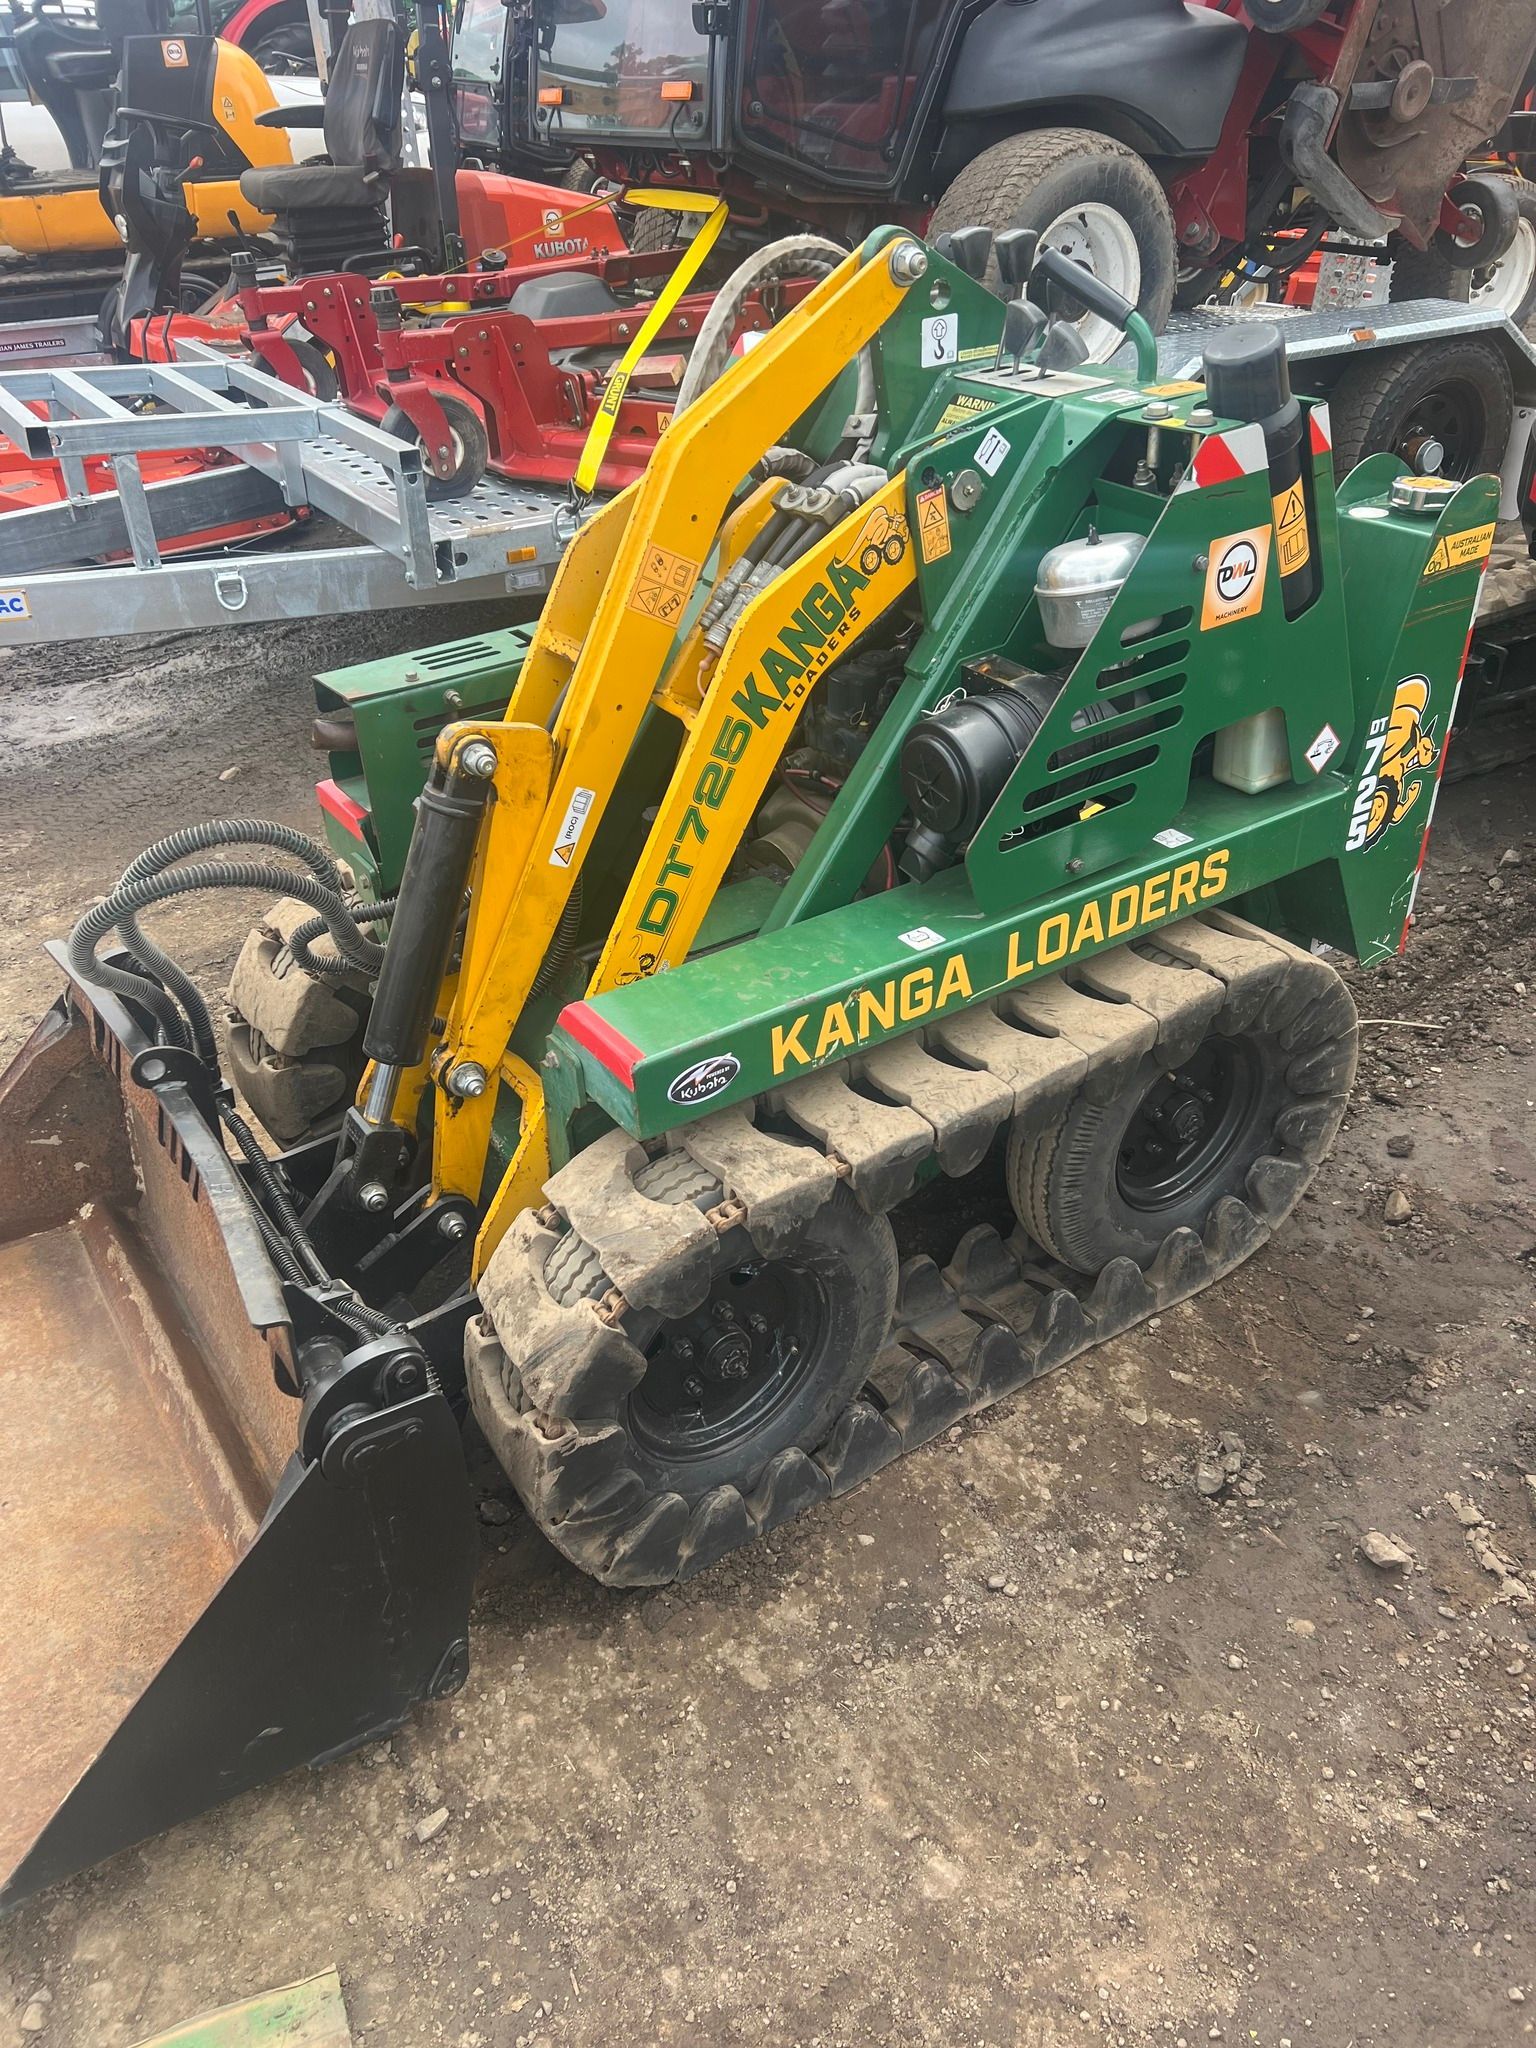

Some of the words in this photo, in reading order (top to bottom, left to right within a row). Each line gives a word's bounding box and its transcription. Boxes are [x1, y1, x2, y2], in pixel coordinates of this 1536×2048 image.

[533, 237, 589, 259] KUBOTA
[14, 342, 34, 351] JAMES
[34, 339, 65, 348] TRAILERS
[604, 375, 626, 412] GRUNT
[956, 395, 998, 411] WARNI
[1450, 531, 1492, 550] AUSTRALIAN
[1459, 545, 1480, 558] MADE
[1219, 560, 1256, 583] DWL
[1215, 605, 1249, 621] MACHINERY
[732, 557, 870, 730] KANGA
[782, 606, 862, 714] LOADERS
[1370, 716, 1390, 736] DT
[636, 713, 754, 937] DT725
[771, 952, 975, 1077] KANGA
[1005, 847, 1230, 981] LOADERS
[706, 1069, 725, 1080] POWERED
[681, 1076, 727, 1099] Kubota
